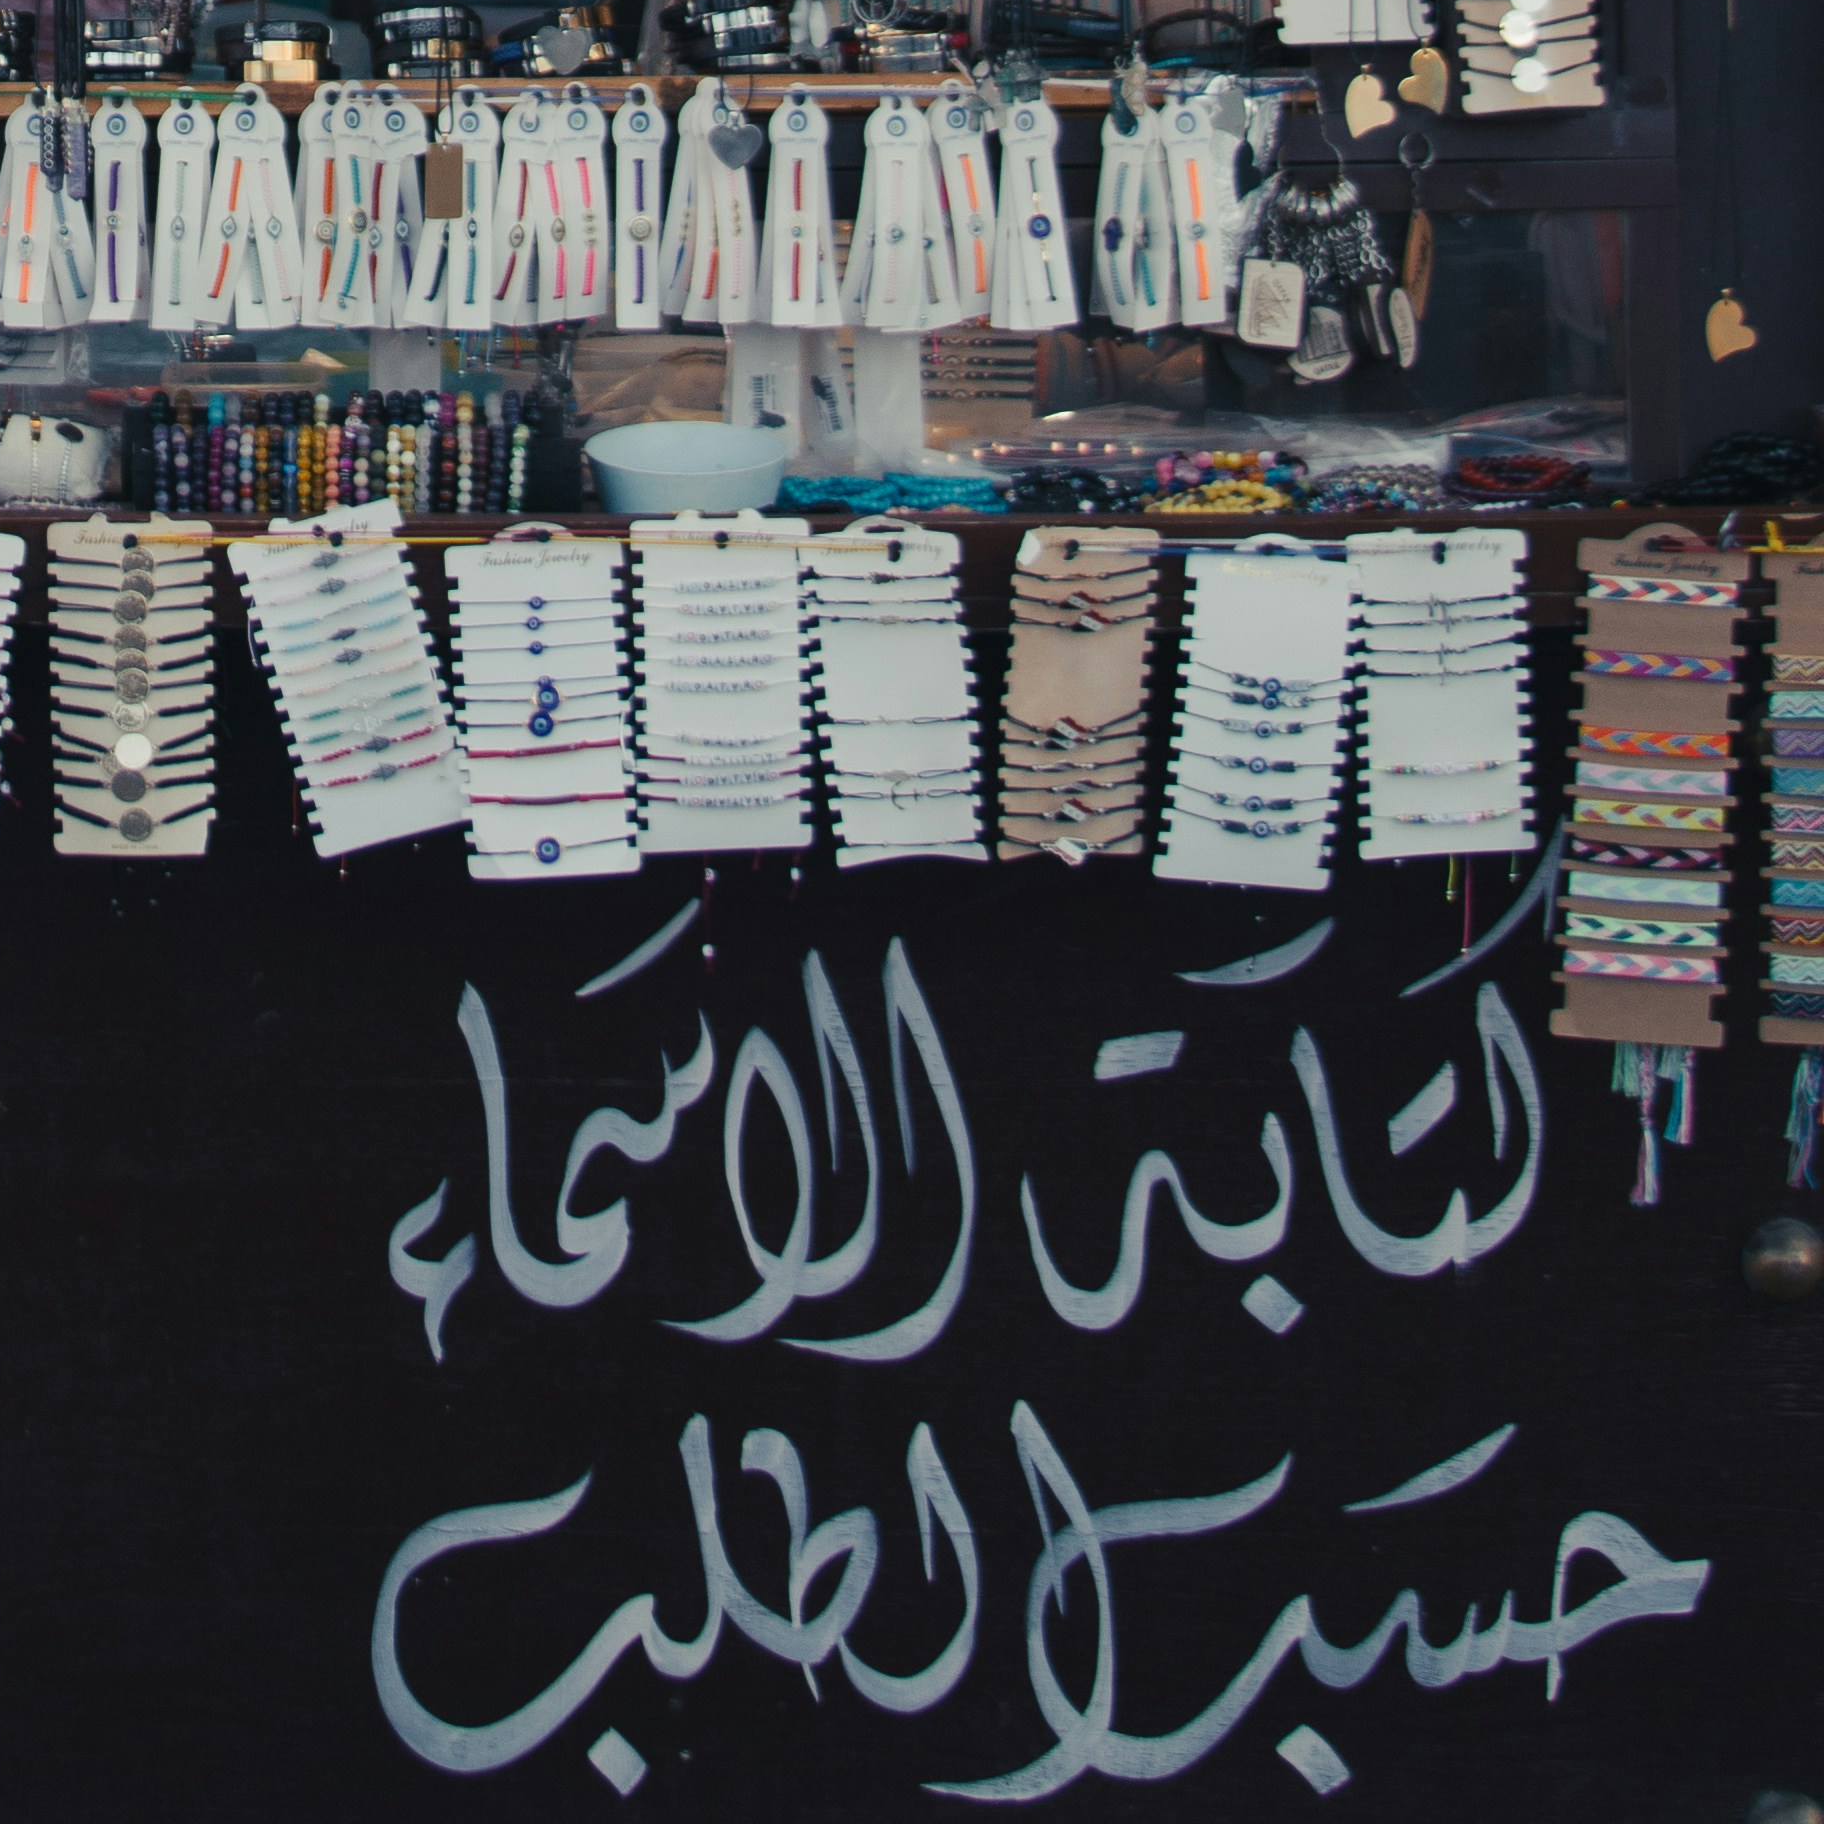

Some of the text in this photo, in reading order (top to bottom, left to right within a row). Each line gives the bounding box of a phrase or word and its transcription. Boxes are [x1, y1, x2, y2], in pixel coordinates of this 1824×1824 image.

[477, 548, 593, 569] Fashion Jewelry
[1664, 558, 1720, 577] Jewelry
[373, 1400, 1711, 1802] حسب الطلب
